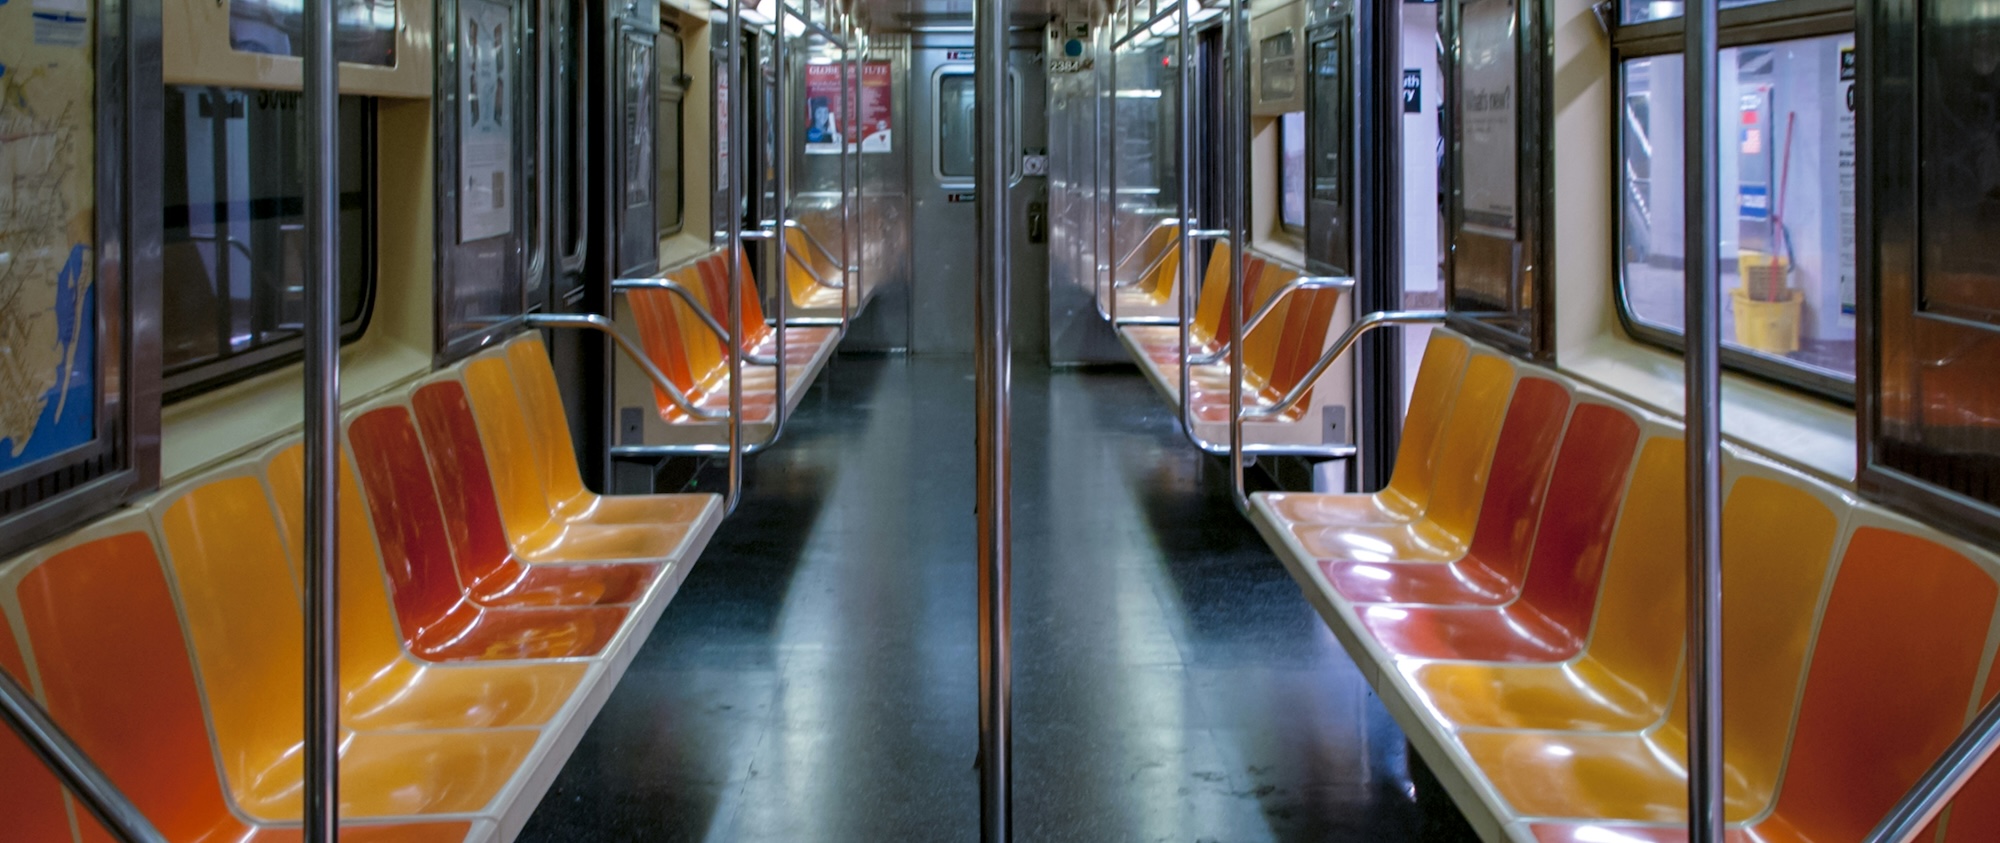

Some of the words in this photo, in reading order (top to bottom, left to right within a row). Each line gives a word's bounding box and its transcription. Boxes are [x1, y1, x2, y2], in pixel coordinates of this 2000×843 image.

[809, 65, 839, 75] GLOBE
[1050, 61, 1078, 72] 2384
[1489, 85, 1510, 111] new?
